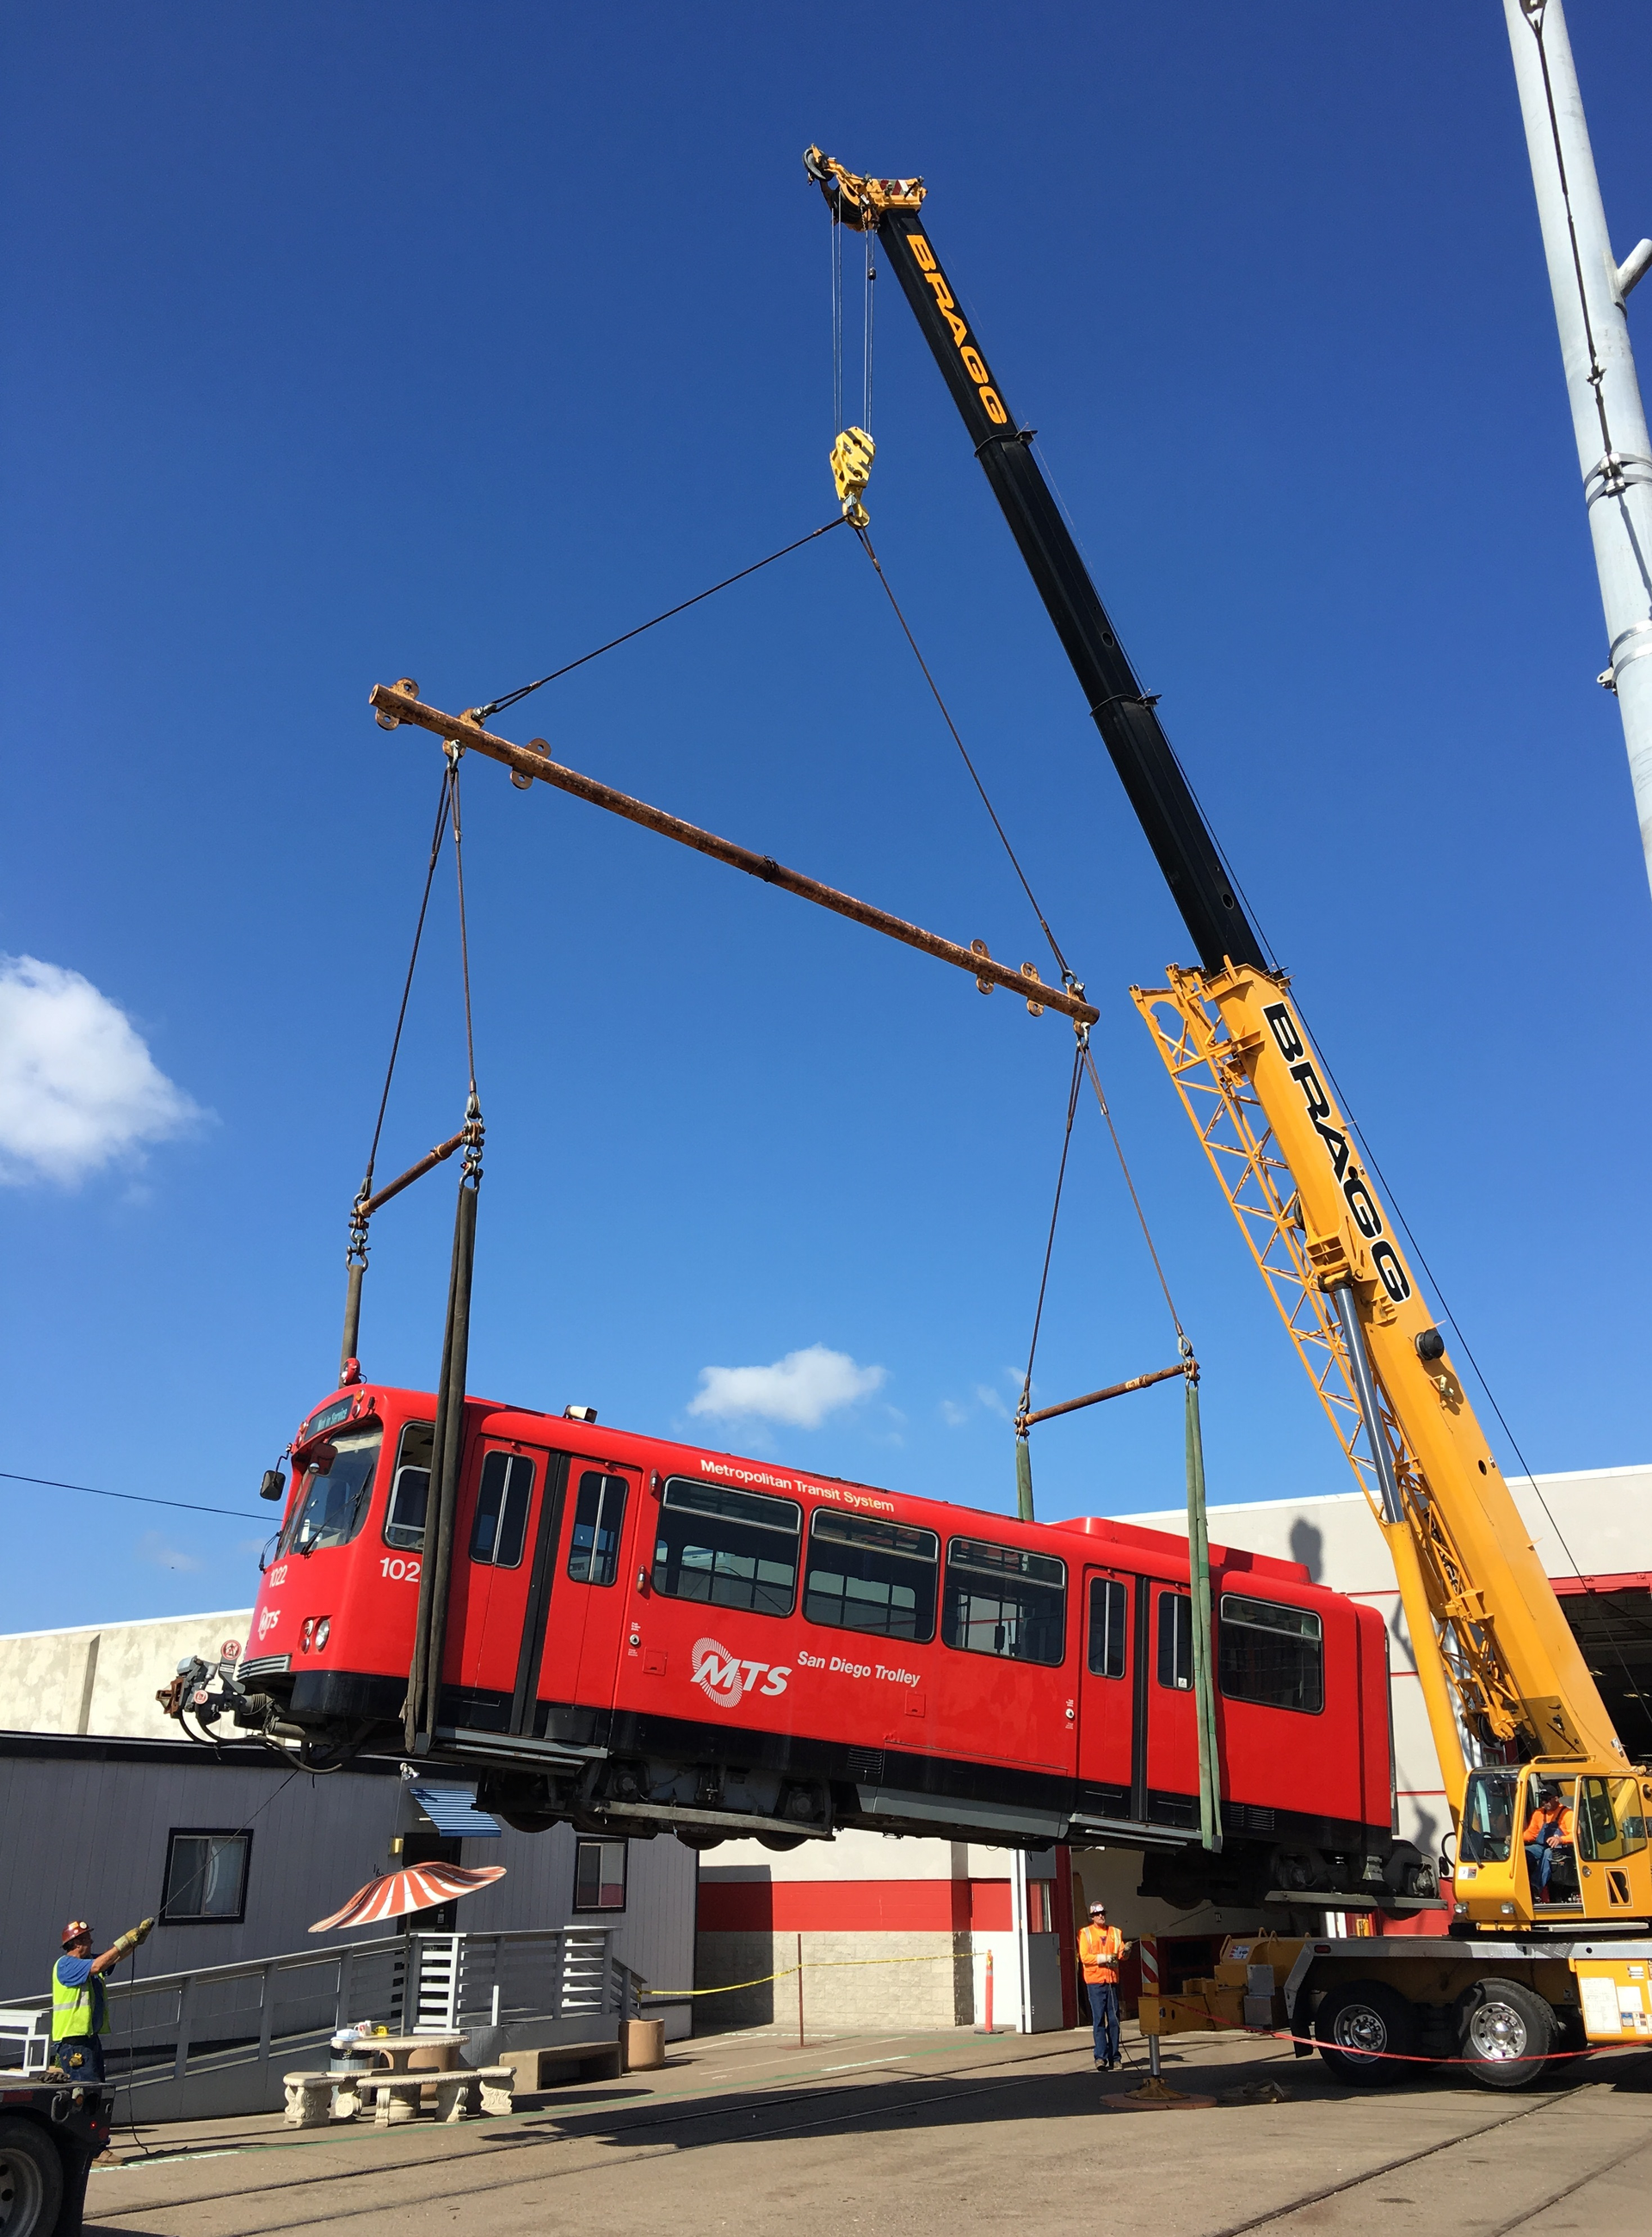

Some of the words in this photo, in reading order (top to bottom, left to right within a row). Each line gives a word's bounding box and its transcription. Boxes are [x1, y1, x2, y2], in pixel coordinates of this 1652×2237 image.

[906, 234, 1008, 424] BRAGG
[1261, 1001, 1412, 1303] BRAGG
[700, 1459, 792, 1489] Metropolitan
[793, 1480, 841, 1501] Transit
[843, 1491, 894, 1512] System
[269, 1564, 288, 1588] 1022
[379, 1556, 421, 1582] 102
[258, 1610, 281, 1632] MTS
[690, 1655, 792, 1697] MTS
[797, 1650, 826, 1669] San
[829, 1656, 872, 1679] Diego
[875, 1664, 921, 1687] Trolley
